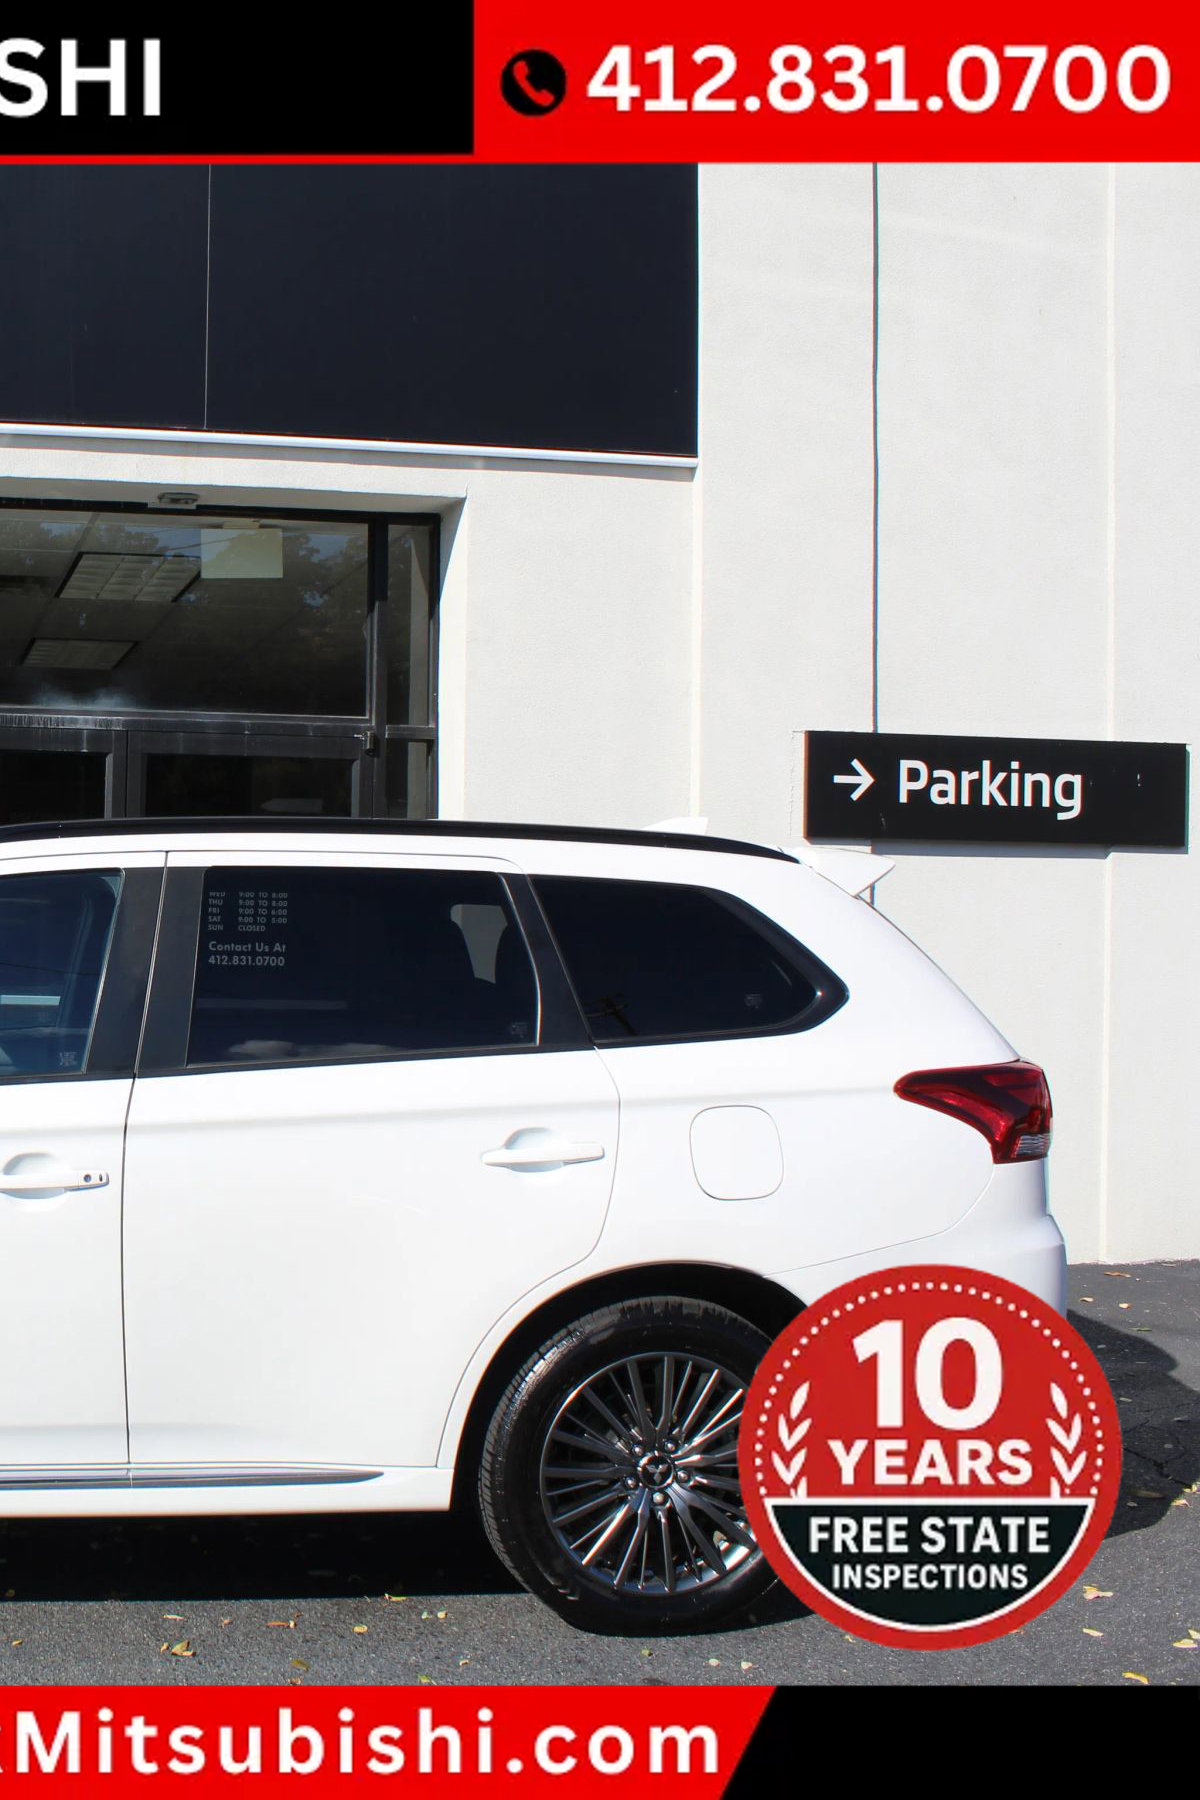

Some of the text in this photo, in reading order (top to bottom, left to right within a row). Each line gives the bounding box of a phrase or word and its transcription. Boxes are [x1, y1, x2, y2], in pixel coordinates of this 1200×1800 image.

[899, 759, 1083, 821] Parking
[208, 941, 286, 952] Contact Us At
[208, 955, 285, 966] 412.831.0700
